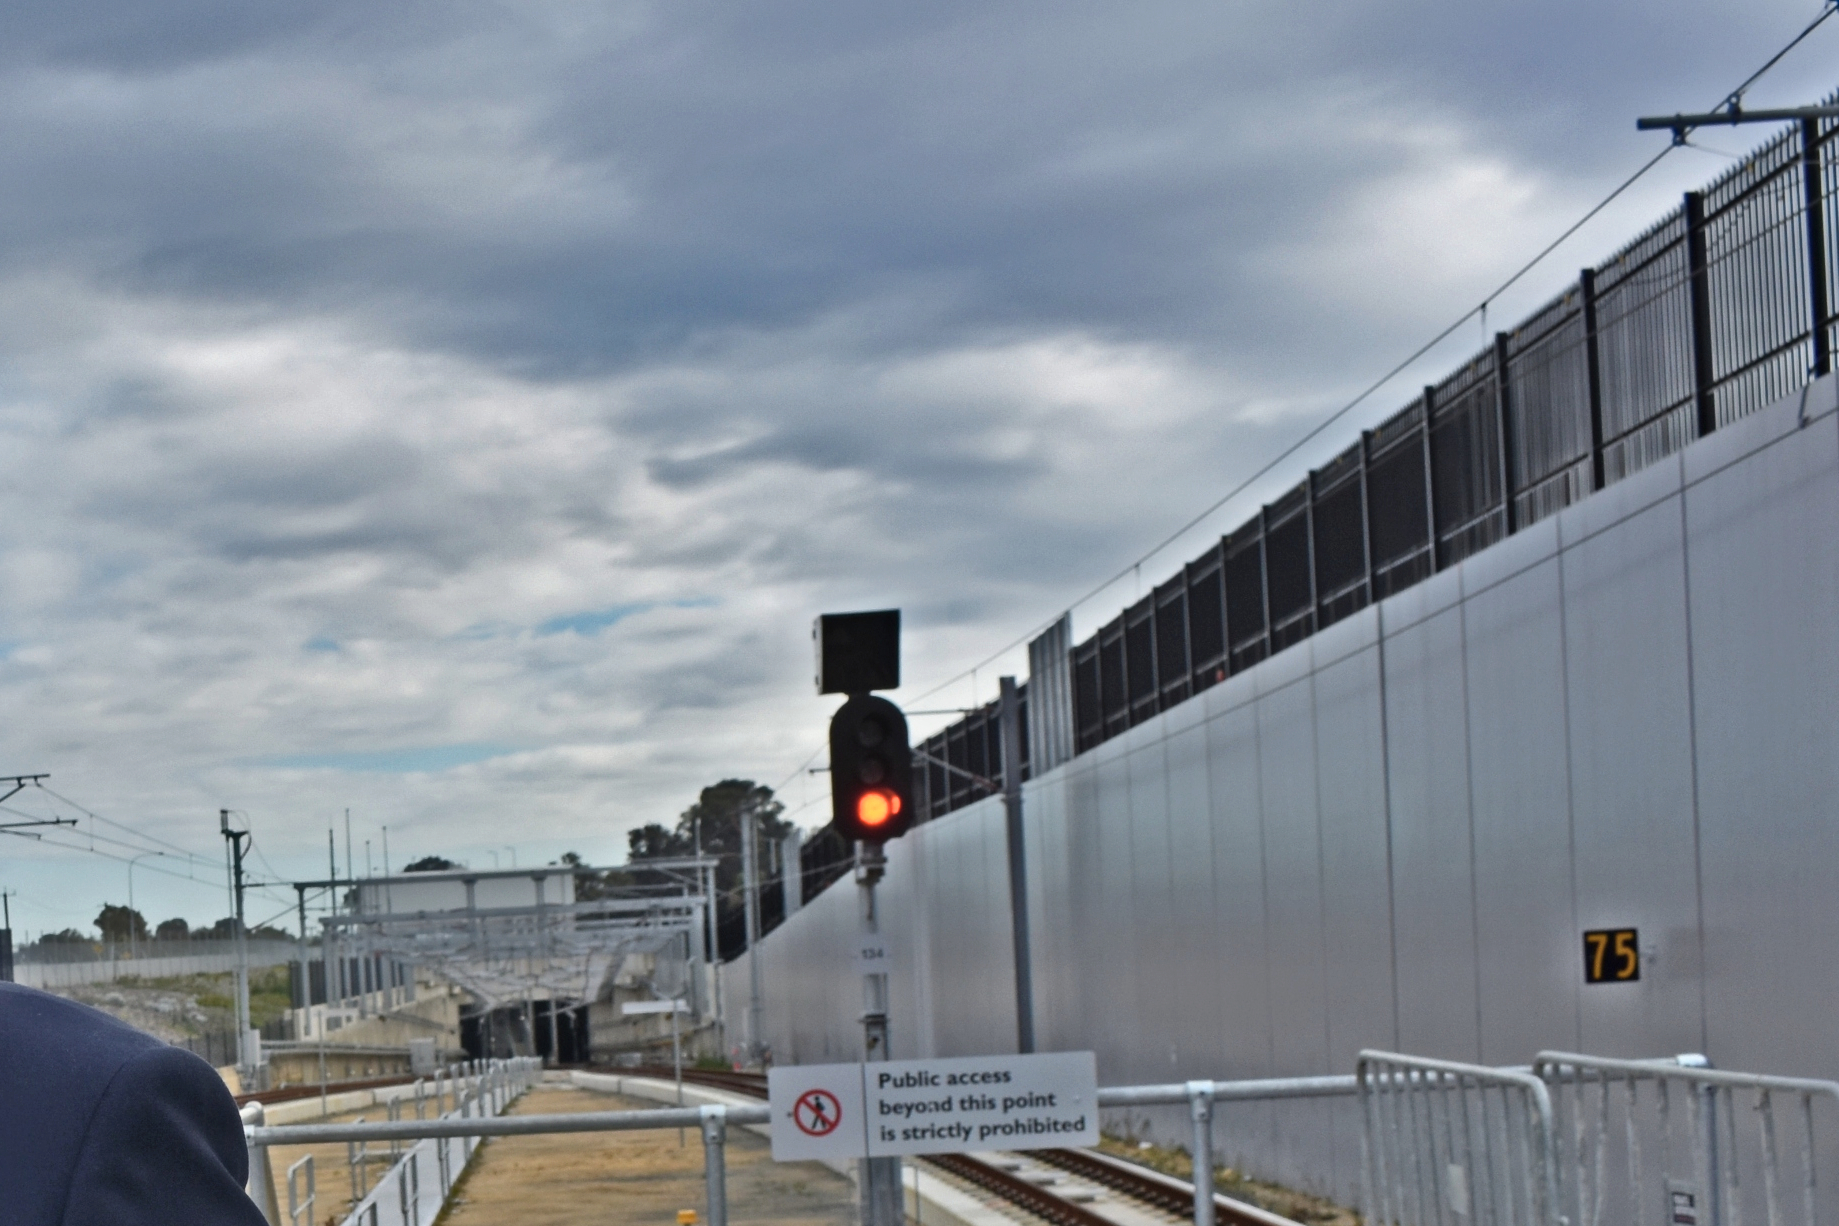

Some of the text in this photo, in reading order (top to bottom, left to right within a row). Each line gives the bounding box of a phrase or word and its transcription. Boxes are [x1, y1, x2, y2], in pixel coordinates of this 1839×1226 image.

[1587, 932, 1637, 980] 75
[878, 1070, 1012, 1089] Public access
[879, 1092, 1057, 1119] beyond this point
[880, 1116, 1086, 1142] is strictly prohibited
